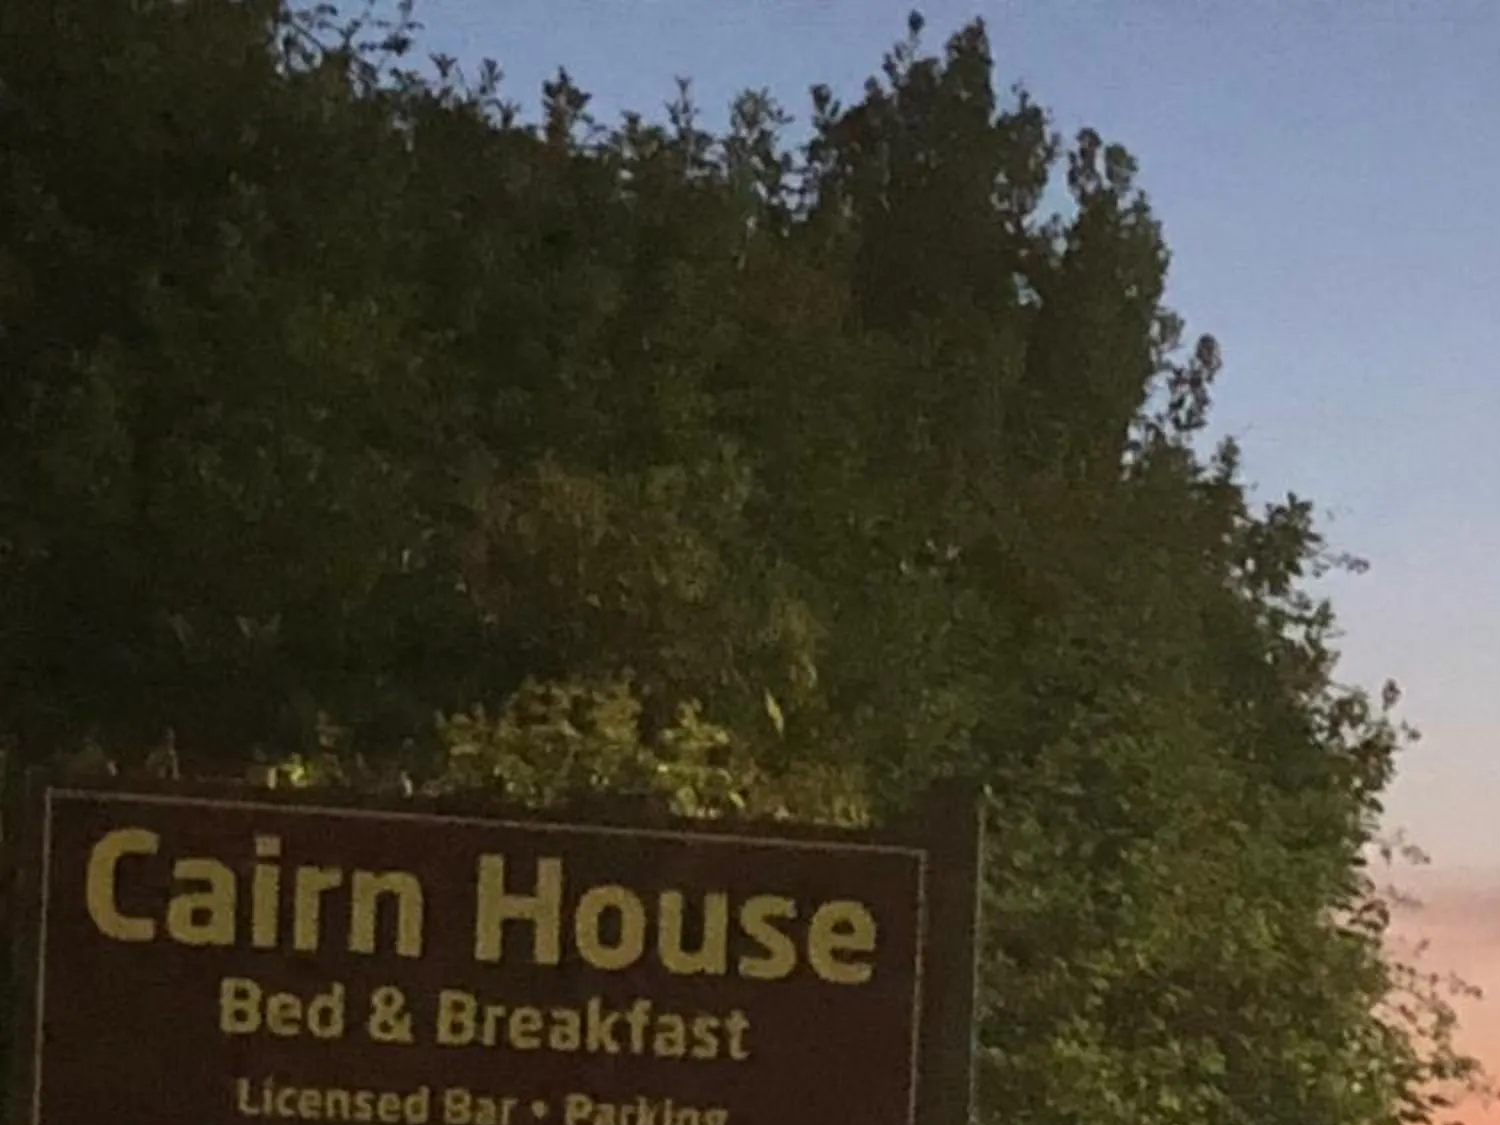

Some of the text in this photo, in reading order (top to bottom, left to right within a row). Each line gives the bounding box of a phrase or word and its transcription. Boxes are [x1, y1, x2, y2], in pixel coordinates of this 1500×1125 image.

[85, 826, 877, 985] Cairn House
[219, 976, 751, 1061] Bed & Breakfast
[236, 1077, 430, 1125] Licensed
